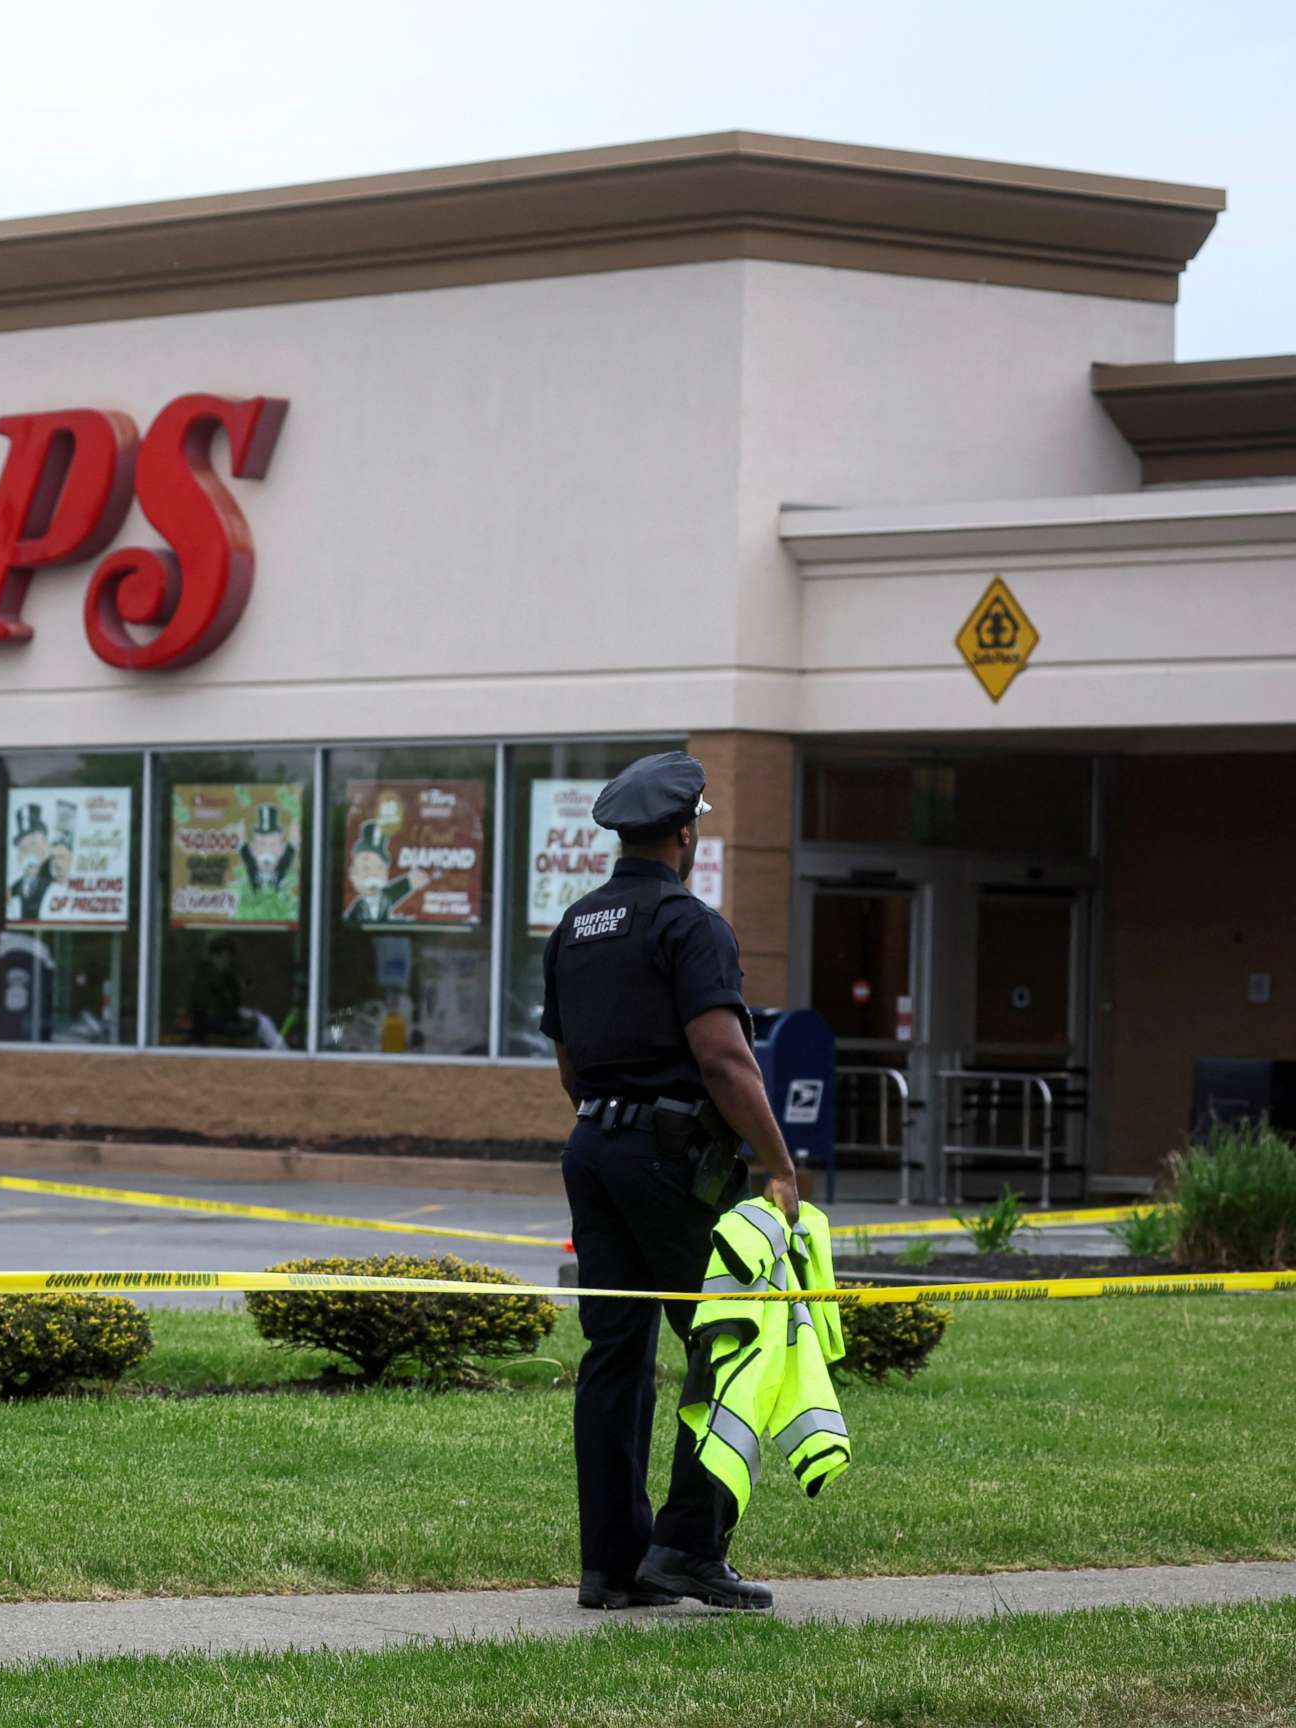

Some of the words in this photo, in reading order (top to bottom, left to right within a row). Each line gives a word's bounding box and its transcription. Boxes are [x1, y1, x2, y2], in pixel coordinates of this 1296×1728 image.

[547, 827, 599, 849] PLAY
[399, 848, 476, 869] DIAMOND
[536, 853, 609, 874] ONLINE
[573, 907, 627, 928] BUFFALO
[575, 920, 619, 939] POLICE
